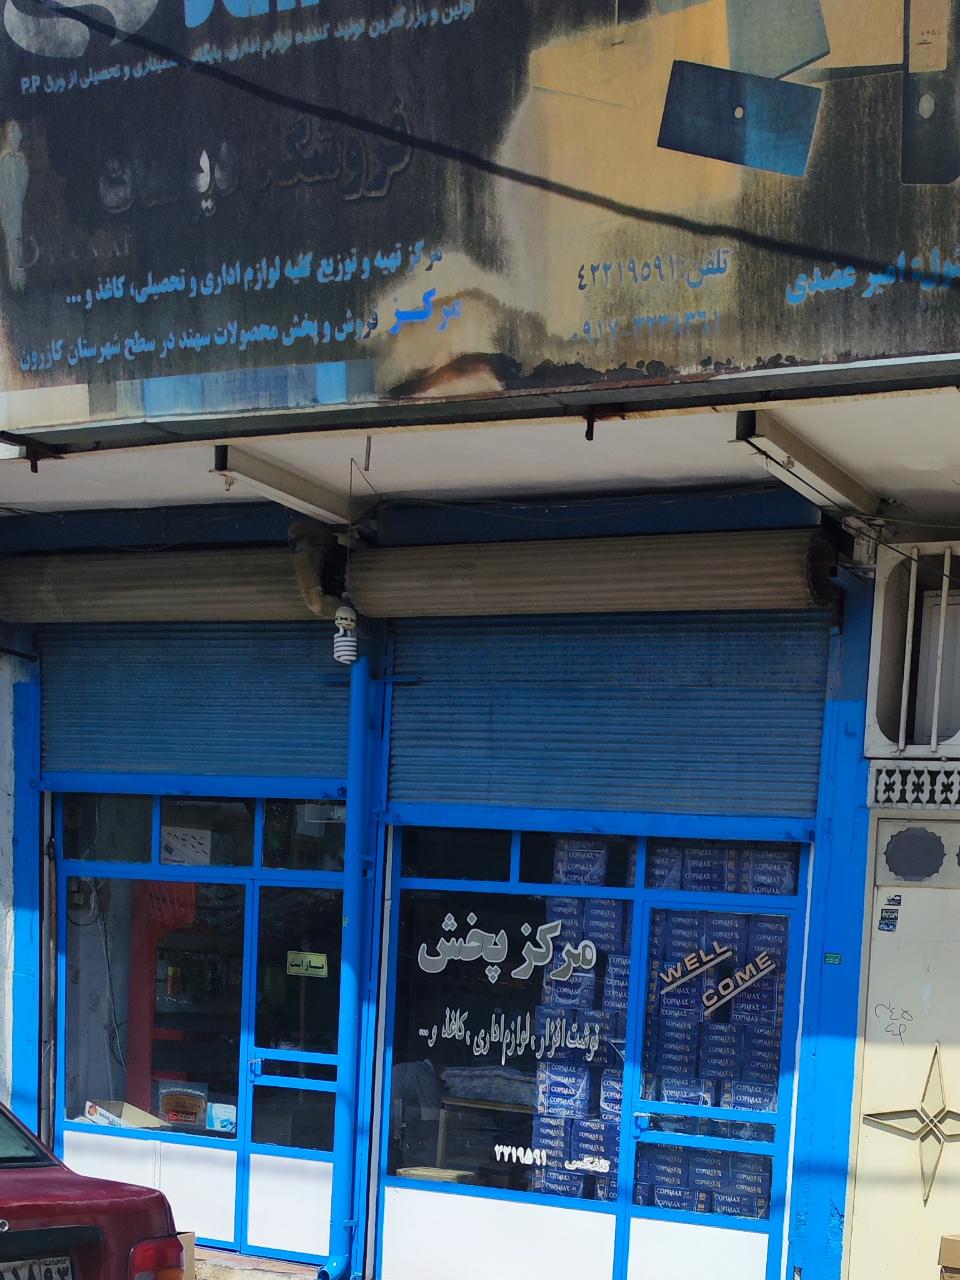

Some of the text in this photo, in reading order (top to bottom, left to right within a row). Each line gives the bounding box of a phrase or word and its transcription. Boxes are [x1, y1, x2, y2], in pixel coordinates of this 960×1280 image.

[200, 259, 241, 296] اداری
[244, 255, 281, 291] لوازم
[284, 251, 313, 285] کلیه
[317, 248, 358, 283] توزیع
[361, 257, 371, 280] و
[95, 274, 125, 300] کاغذ
[189, 276, 197, 298] و
[124, 330, 155, 361] سطح
[159, 329, 176, 358] در
[214, 319, 279, 351] محصولات
[282, 313, 318, 347] پخش
[322, 320, 331, 344] و
[67, 331, 121, 366] شهرستان
[417, 912, 597, 984] مرکز پخش
[659, 940, 730, 983] WELL
[702, 950, 772, 1007] COME
[428, 1025, 437, 1047] و
[501, 1011, 530, 1066] لوازم
[566, 1022, 600, 1061] نوشت
